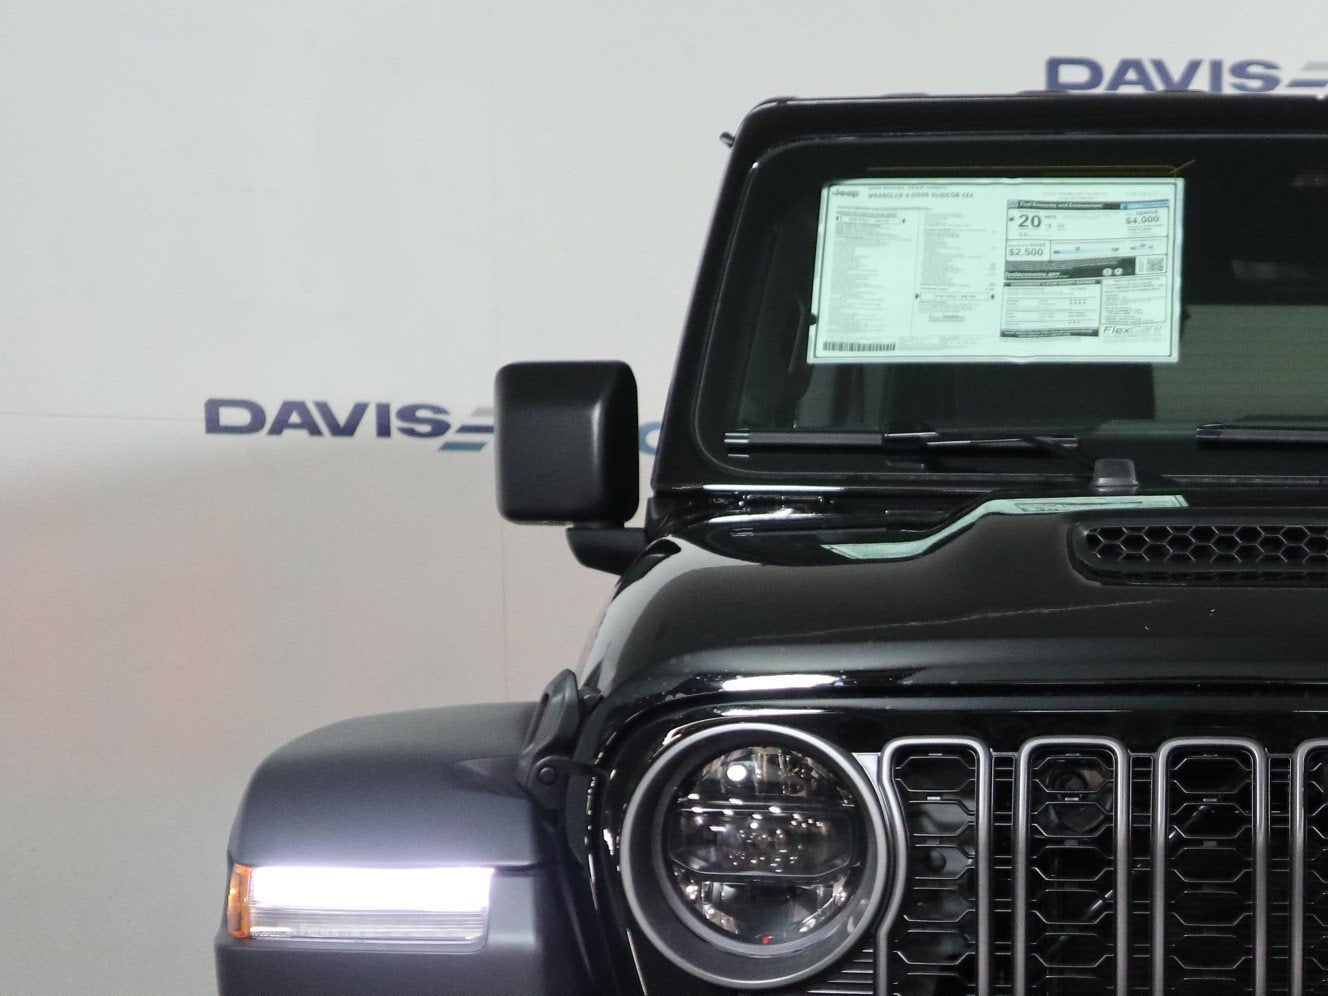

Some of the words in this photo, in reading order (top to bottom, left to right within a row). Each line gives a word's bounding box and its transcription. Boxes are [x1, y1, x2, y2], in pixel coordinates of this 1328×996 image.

[1044, 57, 1281, 92] DAVIS
[867, 191, 904, 199] WRANGLER
[1018, 213, 1042, 228] 20
[1125, 215, 1160, 225] $4,000
[1008, 248, 1044, 257] $2,500
[1103, 324, 1163, 335] FlexCare
[204, 398, 451, 438] DAVIS
